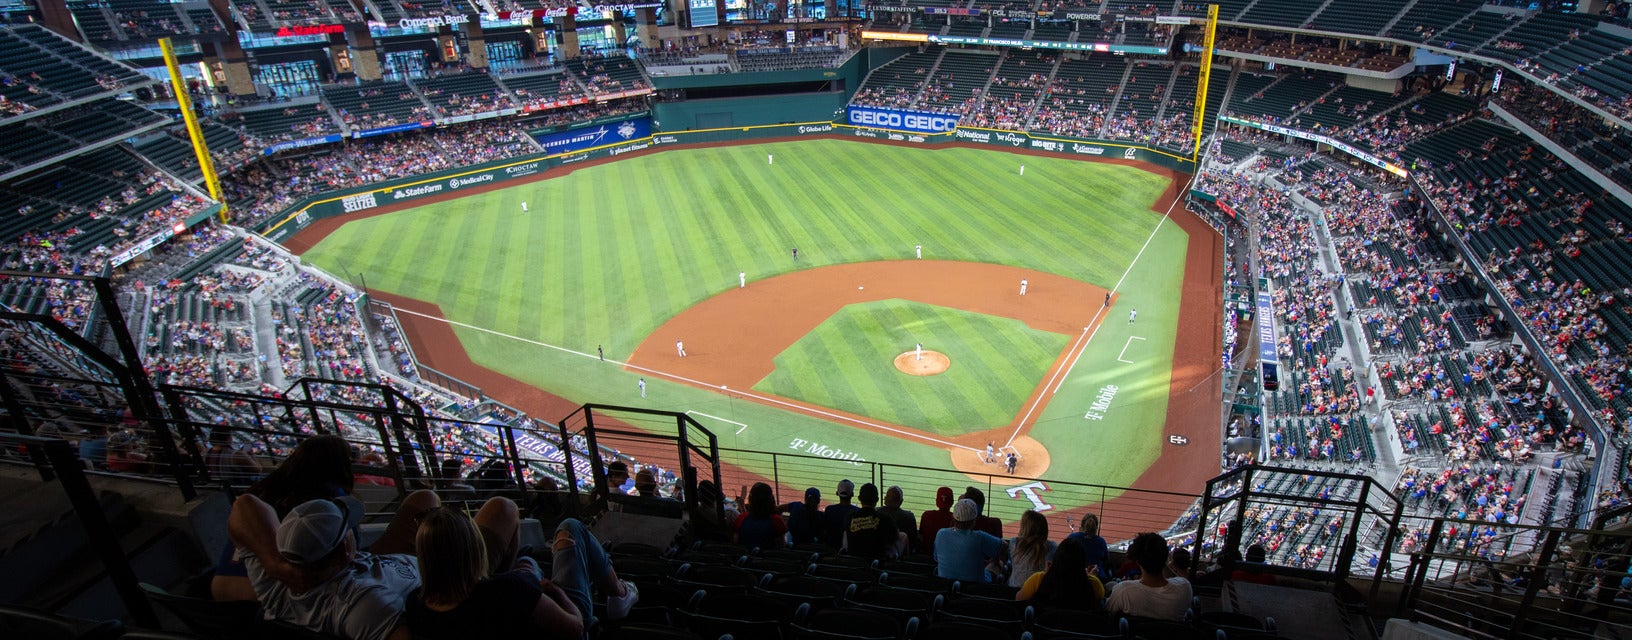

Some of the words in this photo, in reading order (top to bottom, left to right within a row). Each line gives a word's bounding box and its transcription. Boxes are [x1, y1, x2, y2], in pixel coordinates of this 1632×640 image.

[444, 14, 470, 24] Bank
[1067, 13, 1101, 21] POWERADE
[850, 110, 901, 127] GEICO
[904, 115, 957, 132] GEICO
[541, 138, 571, 147] OCKHEED
[571, 135, 594, 143] MARTIN
[963, 131, 991, 140] National
[1005, 133, 1026, 146] Kroger
[507, 163, 538, 174] CHOCTAW
[343, 197, 378, 213] SELTZER
[1259, 306, 1272, 328] RANGERS
[1260, 327, 1274, 343] TEXAS
[514, 433, 553, 454] TEXAS
[548, 449, 594, 477] RAGER
